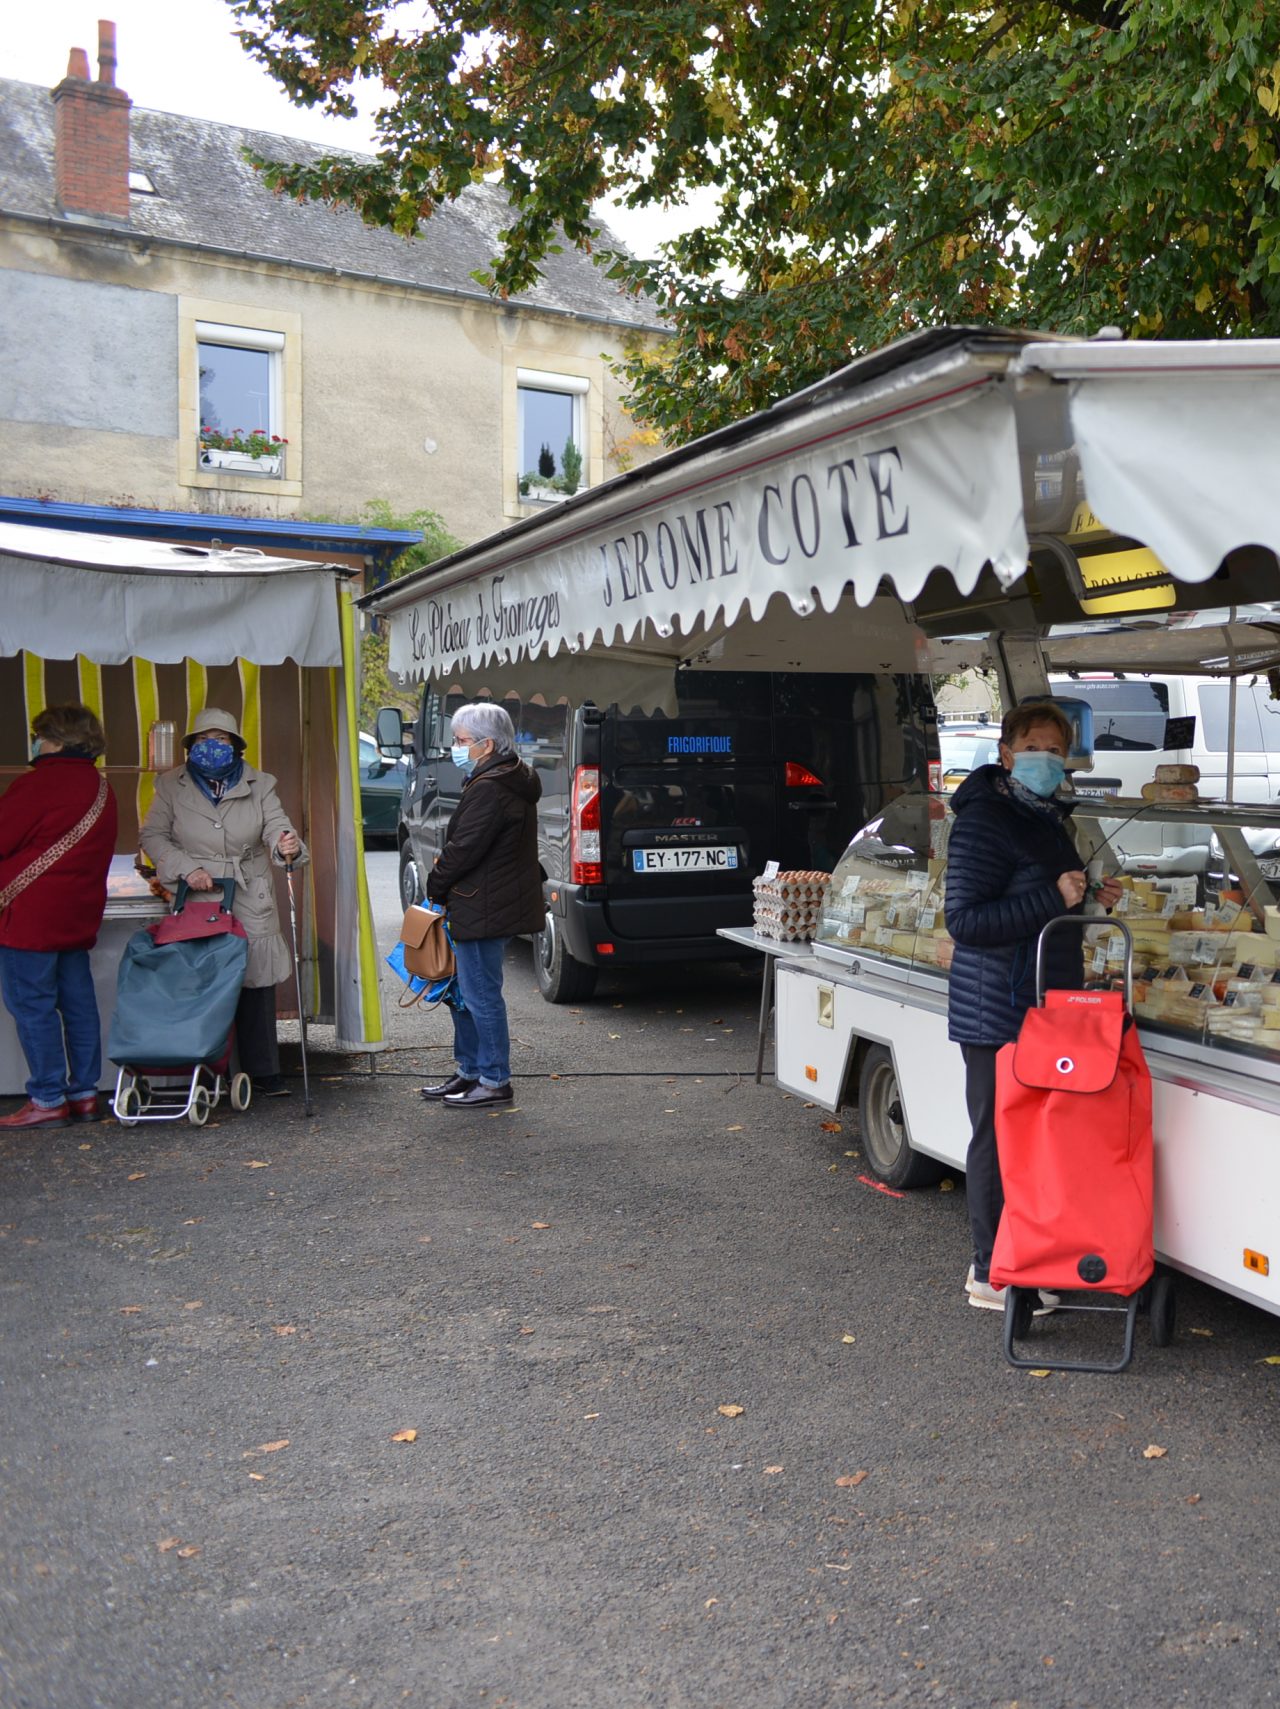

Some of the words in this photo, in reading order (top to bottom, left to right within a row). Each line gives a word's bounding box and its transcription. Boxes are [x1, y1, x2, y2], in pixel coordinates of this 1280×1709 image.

[599, 501, 738, 607] JEROME
[758, 446, 909, 566] COTE
[408, 607, 426, 662] Le
[477, 592, 490, 647] de
[492, 575, 560, 649] Fromages
[668, 736, 731, 752] FRIGORIFIQUE
[655, 834, 718, 842] MASTER
[728, 857, 737, 866] 18
